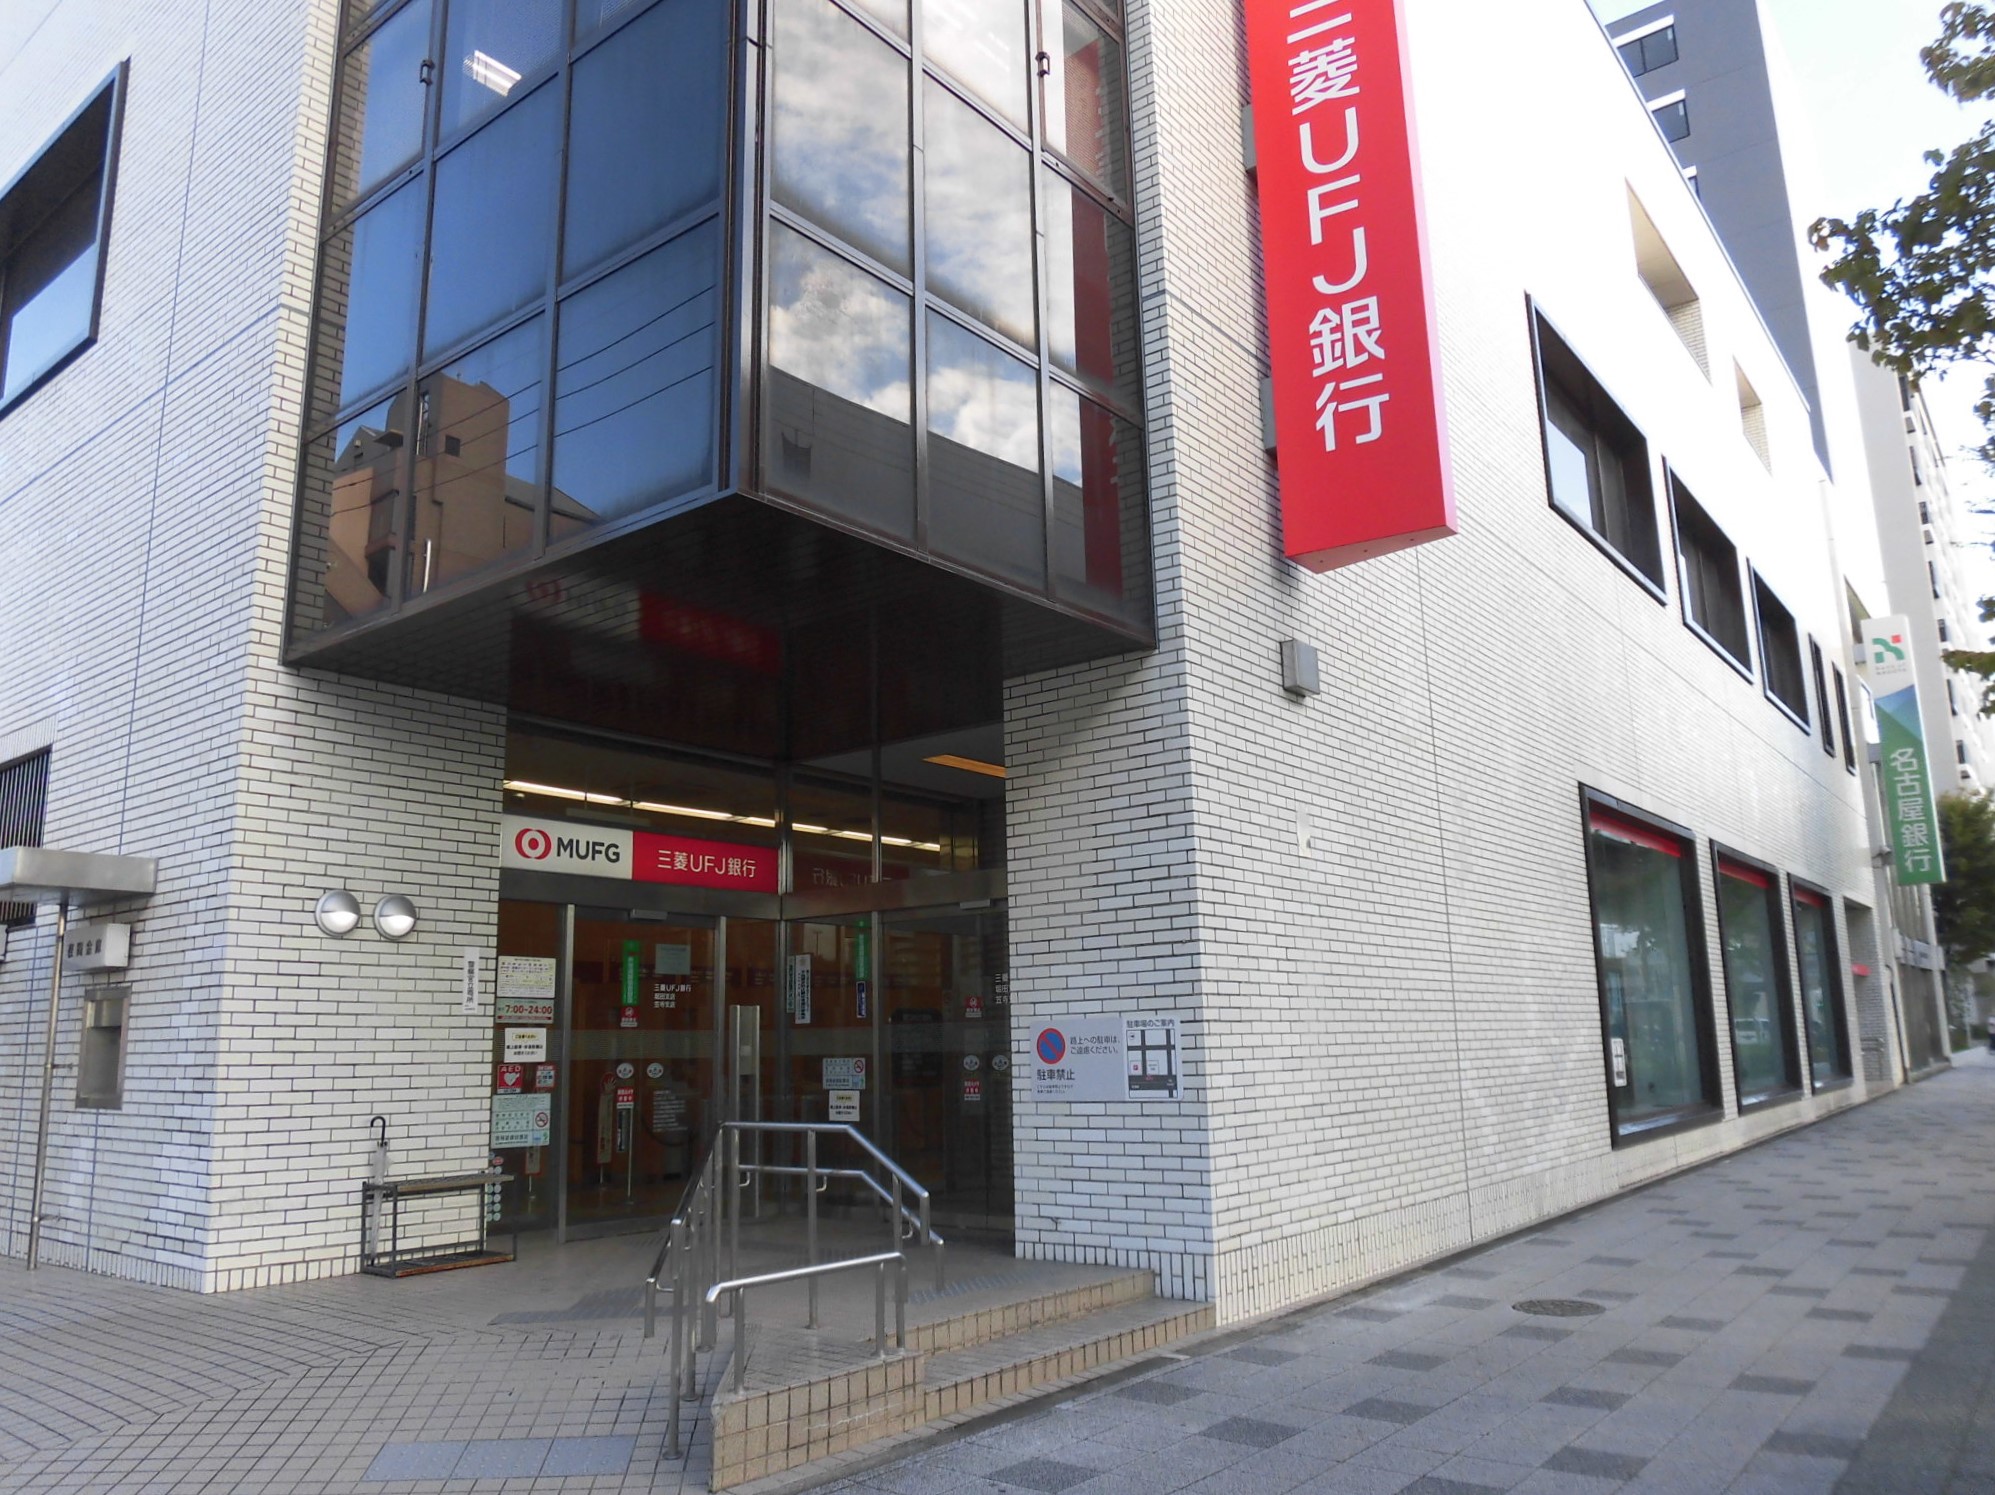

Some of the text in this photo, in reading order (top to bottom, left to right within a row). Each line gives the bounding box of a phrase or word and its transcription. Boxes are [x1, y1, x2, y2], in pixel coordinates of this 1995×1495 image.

[1890, 747, 1932, 873] 名古屋銀行
[556, 837, 620, 863] MUFG
[657, 850, 756, 878] 三菱UFJ銀行
[1126, 1019, 1175, 1028] 駐車場のご案内
[500, 1065, 521, 1073] AED
[1037, 1069, 1076, 1081] 駐車禁止
